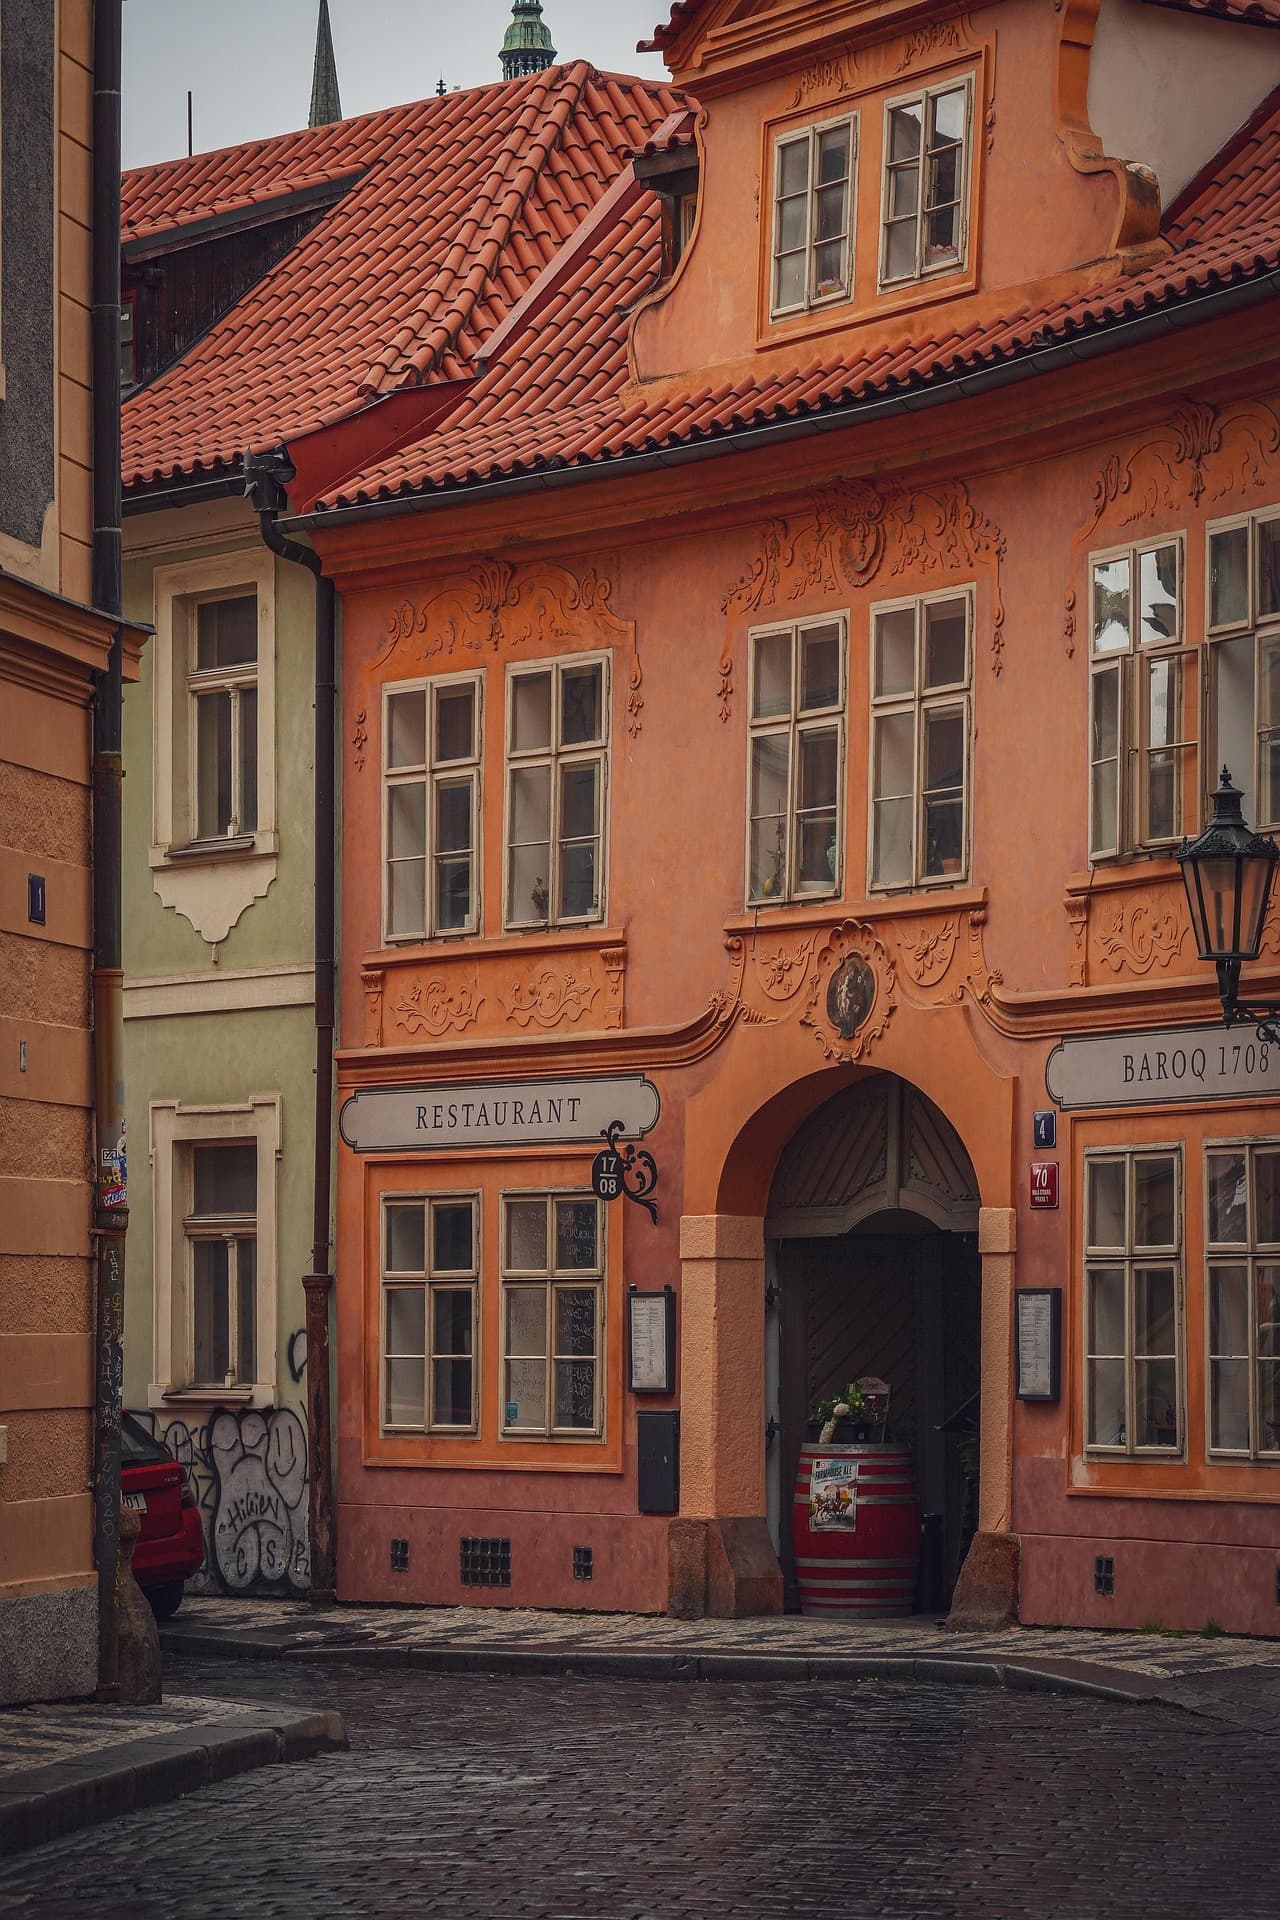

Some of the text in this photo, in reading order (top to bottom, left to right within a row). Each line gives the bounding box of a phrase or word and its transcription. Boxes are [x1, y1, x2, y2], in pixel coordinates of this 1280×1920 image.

[1122, 1043, 1269, 1083] BAROQ 1708
[415, 1097, 582, 1130] RESTAURANT
[1039, 1119, 1046, 1139] 4
[600, 1156, 616, 1172] 17
[599, 1178, 617, 1195] 08
[1035, 1168, 1048, 1188] 70
[843, 1464, 853, 1475] ALE
